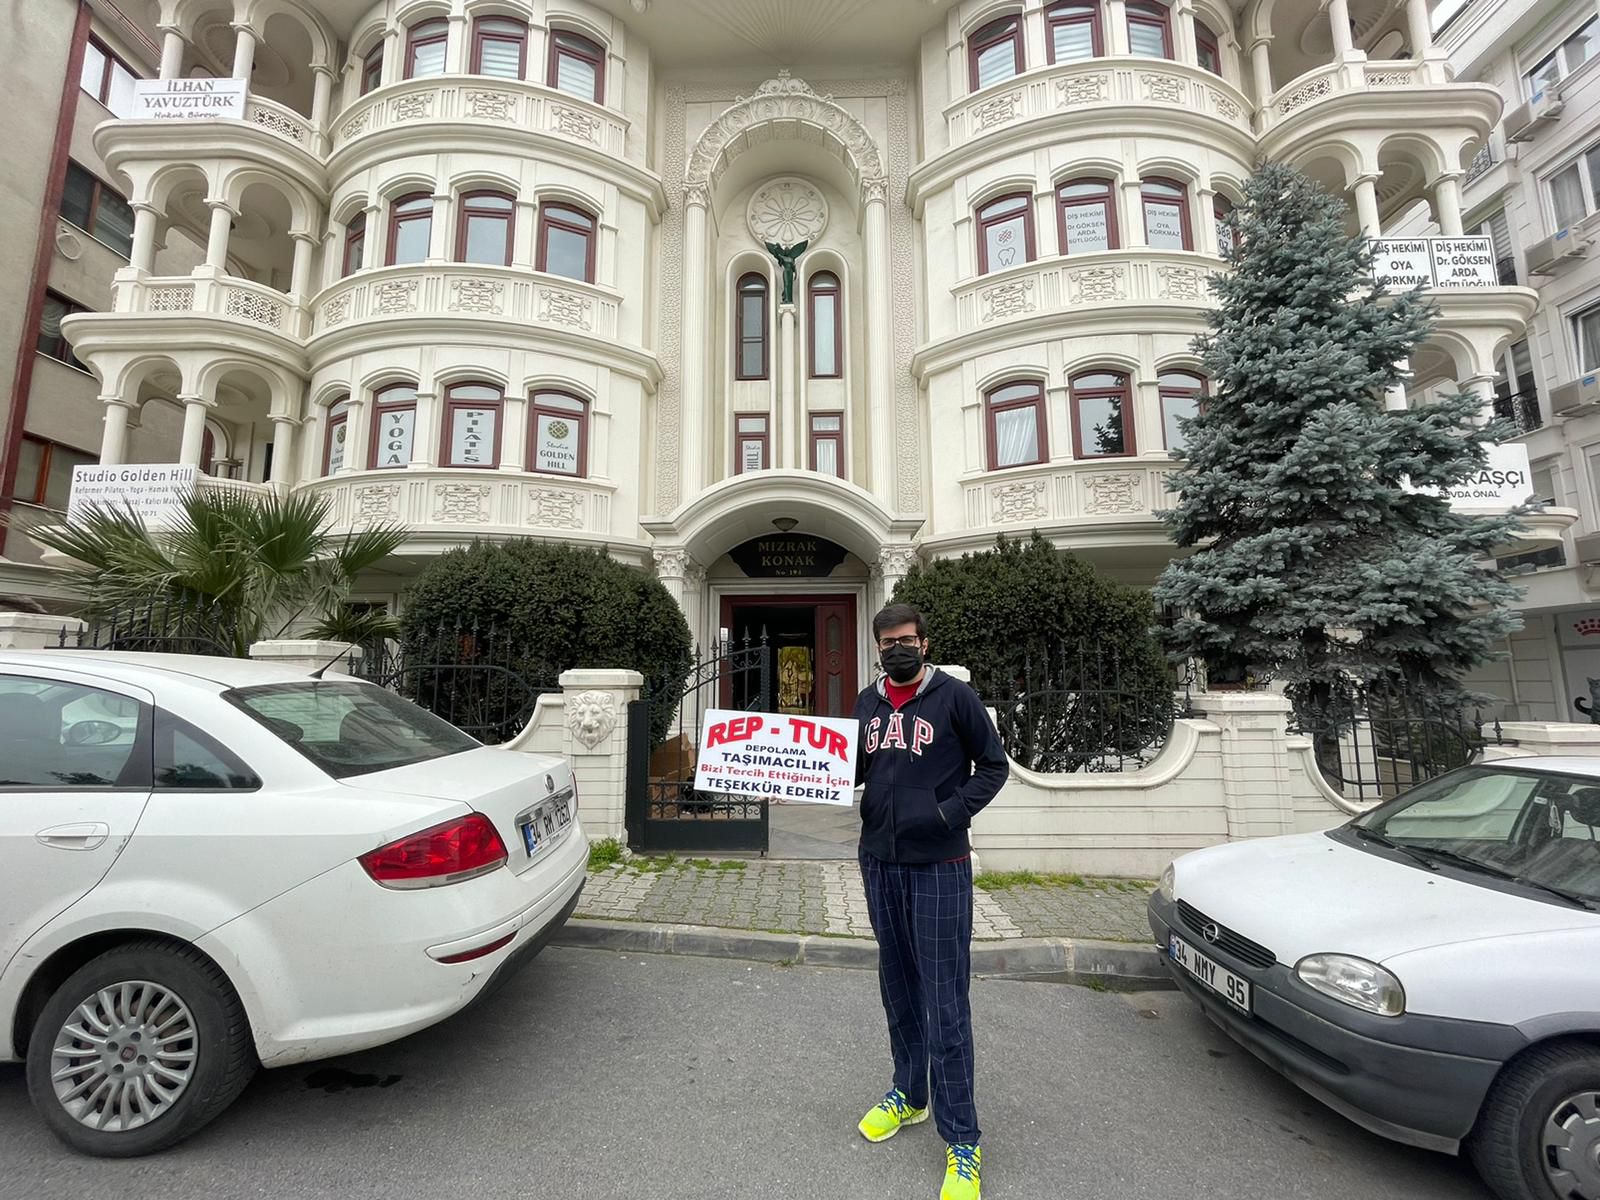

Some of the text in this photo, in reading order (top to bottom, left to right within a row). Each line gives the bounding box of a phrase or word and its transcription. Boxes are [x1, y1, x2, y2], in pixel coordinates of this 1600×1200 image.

[144, 95, 235, 108] YAVUZTÜRK
[1391, 240, 1426, 253] HEKİMİ
[1435, 239, 1488, 255] DİŞ HEKİMİ
[1390, 260, 1414, 271] OYA
[1436, 253, 1491, 266] Dr. GÖKSEN
[1451, 267, 1479, 277] ARDA
[387, 414, 404, 464] YOGA
[540, 449, 575, 461] GOLDEN
[547, 460, 567, 469] HILL
[75, 468, 193, 483] Studio Golden Hill
[130, 486, 144, 494] Yoga
[758, 541, 817, 552] MIZRAK
[761, 555, 815, 567] KONAK
[706, 716, 764, 749] REP
[788, 717, 849, 763] TUR
[864, 712, 934, 756] GAP
[745, 744, 807, 757] DEPOLAMA
[722, 752, 831, 772] TAŞIMACILIK
[700, 763, 850, 788] Bizi Tercih Ettiğiniz İçin
[706, 777, 841, 801] TEŞEKKÜR EDERİZ
[529, 821, 542, 845] 34
[1175, 940, 1188, 966] 34
[1194, 952, 1216, 986] NMY
[1226, 974, 1245, 1006] 95
